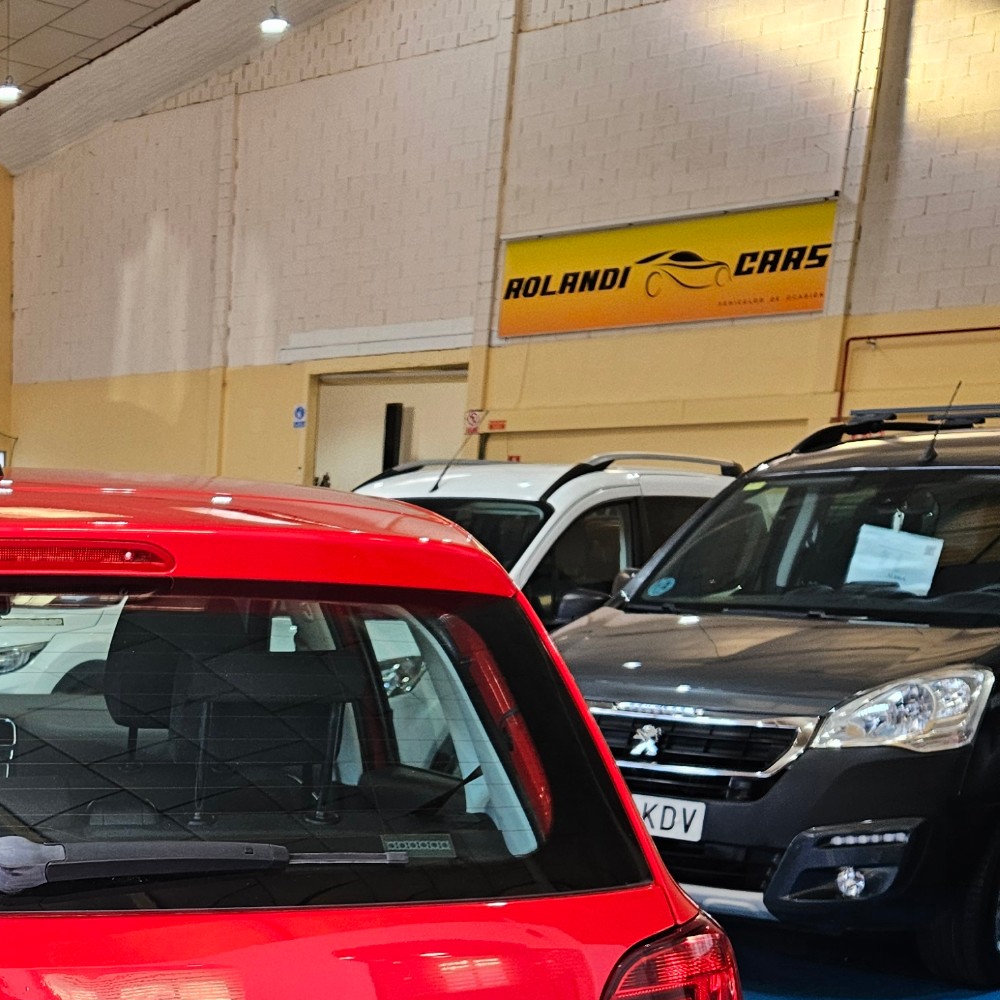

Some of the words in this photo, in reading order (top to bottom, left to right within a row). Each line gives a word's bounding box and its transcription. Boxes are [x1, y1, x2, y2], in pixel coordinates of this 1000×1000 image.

[503, 266, 632, 300] ROLANDI
[734, 243, 832, 276] CARS
[642, 803, 697, 833] KDV
